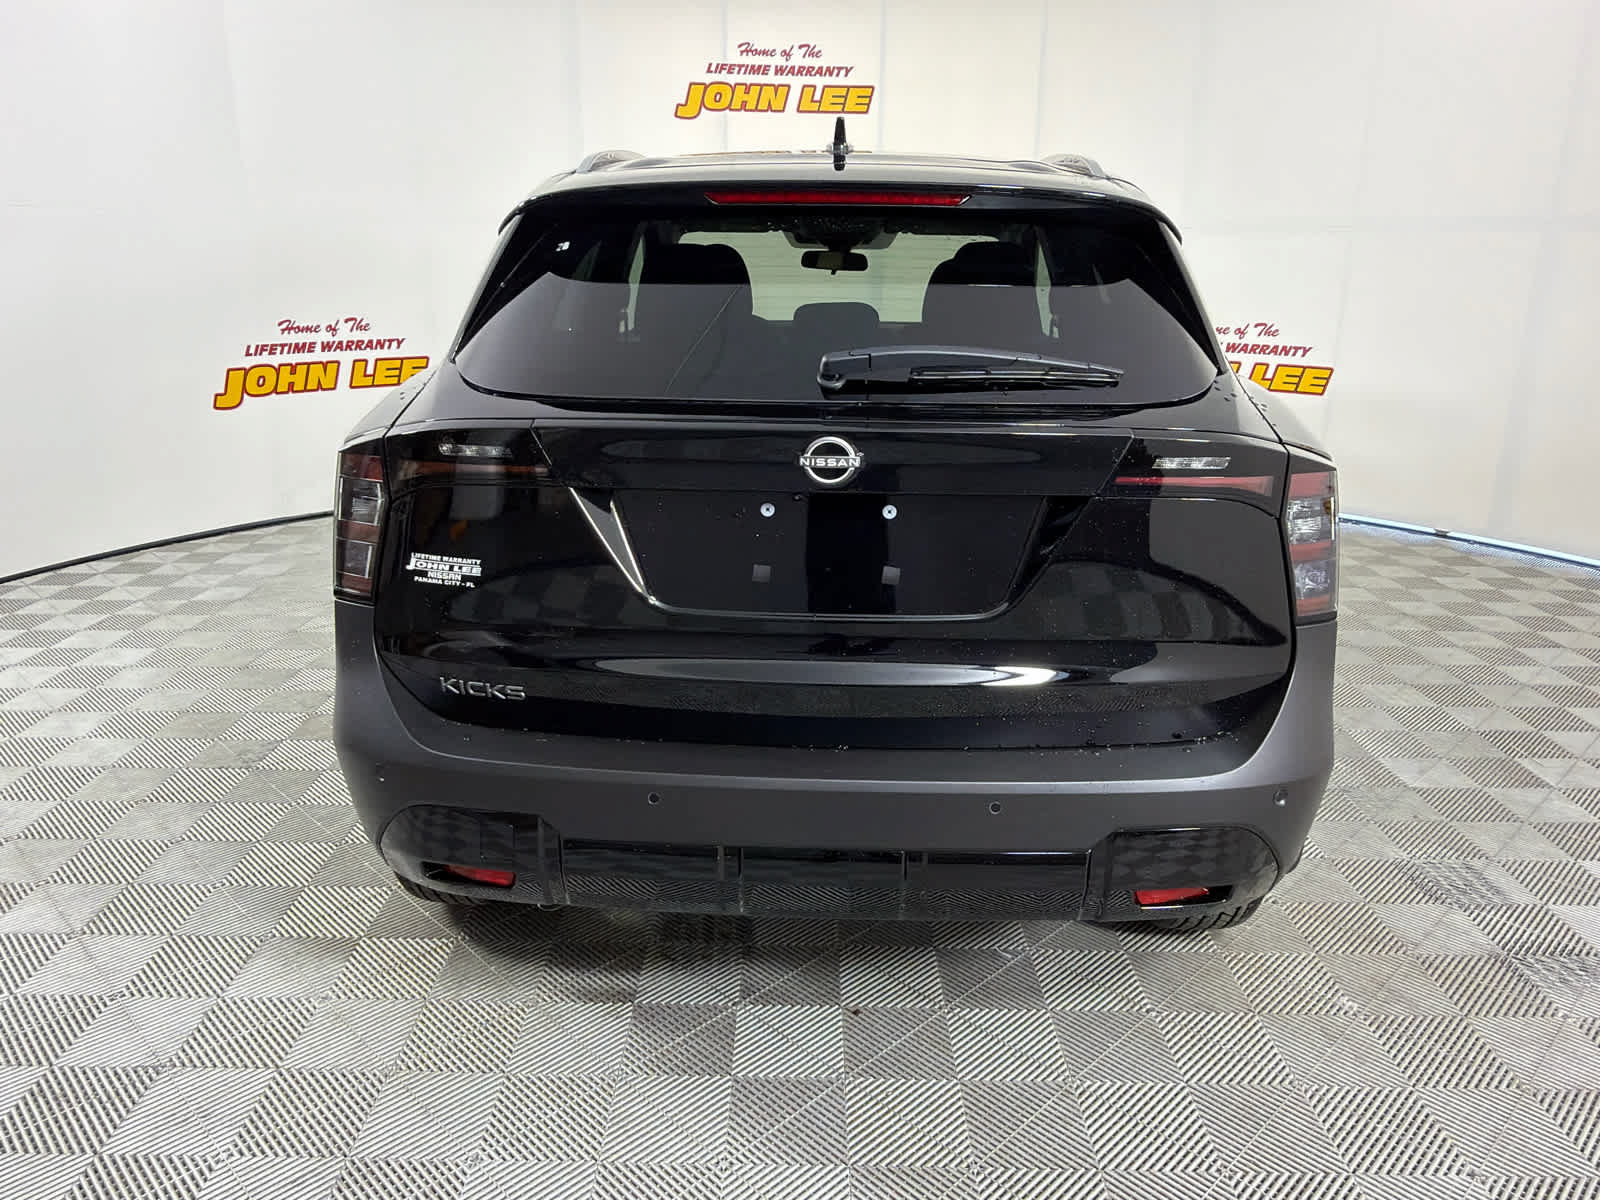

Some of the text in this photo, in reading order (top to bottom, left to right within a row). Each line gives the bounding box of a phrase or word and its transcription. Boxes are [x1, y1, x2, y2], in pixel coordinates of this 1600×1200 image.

[737, 42, 823, 61] Home of The
[705, 62, 854, 78] LIFETIME WARRANTY
[674, 81, 875, 120] JOHN LEE
[277, 317, 371, 337] Home of The
[1233, 323, 1250, 340] of
[1254, 322, 1280, 337] The
[244, 338, 406, 357] LIFETIME WARRANTY
[1225, 342, 1312, 358] WARRANTY
[213, 360, 341, 411] JOHN
[1248, 362, 1334, 396] LEE
[800, 456, 861, 468] NISSAN
[405, 557, 482, 576] JOHN LEE
[411, 552, 482, 565] LIFETIME WARRANTY
[414, 576, 443, 585] PANAMA
[444, 579, 461, 587] CITY
[427, 571, 462, 581] NISSAN
[439, 676, 527, 701] KICKS
